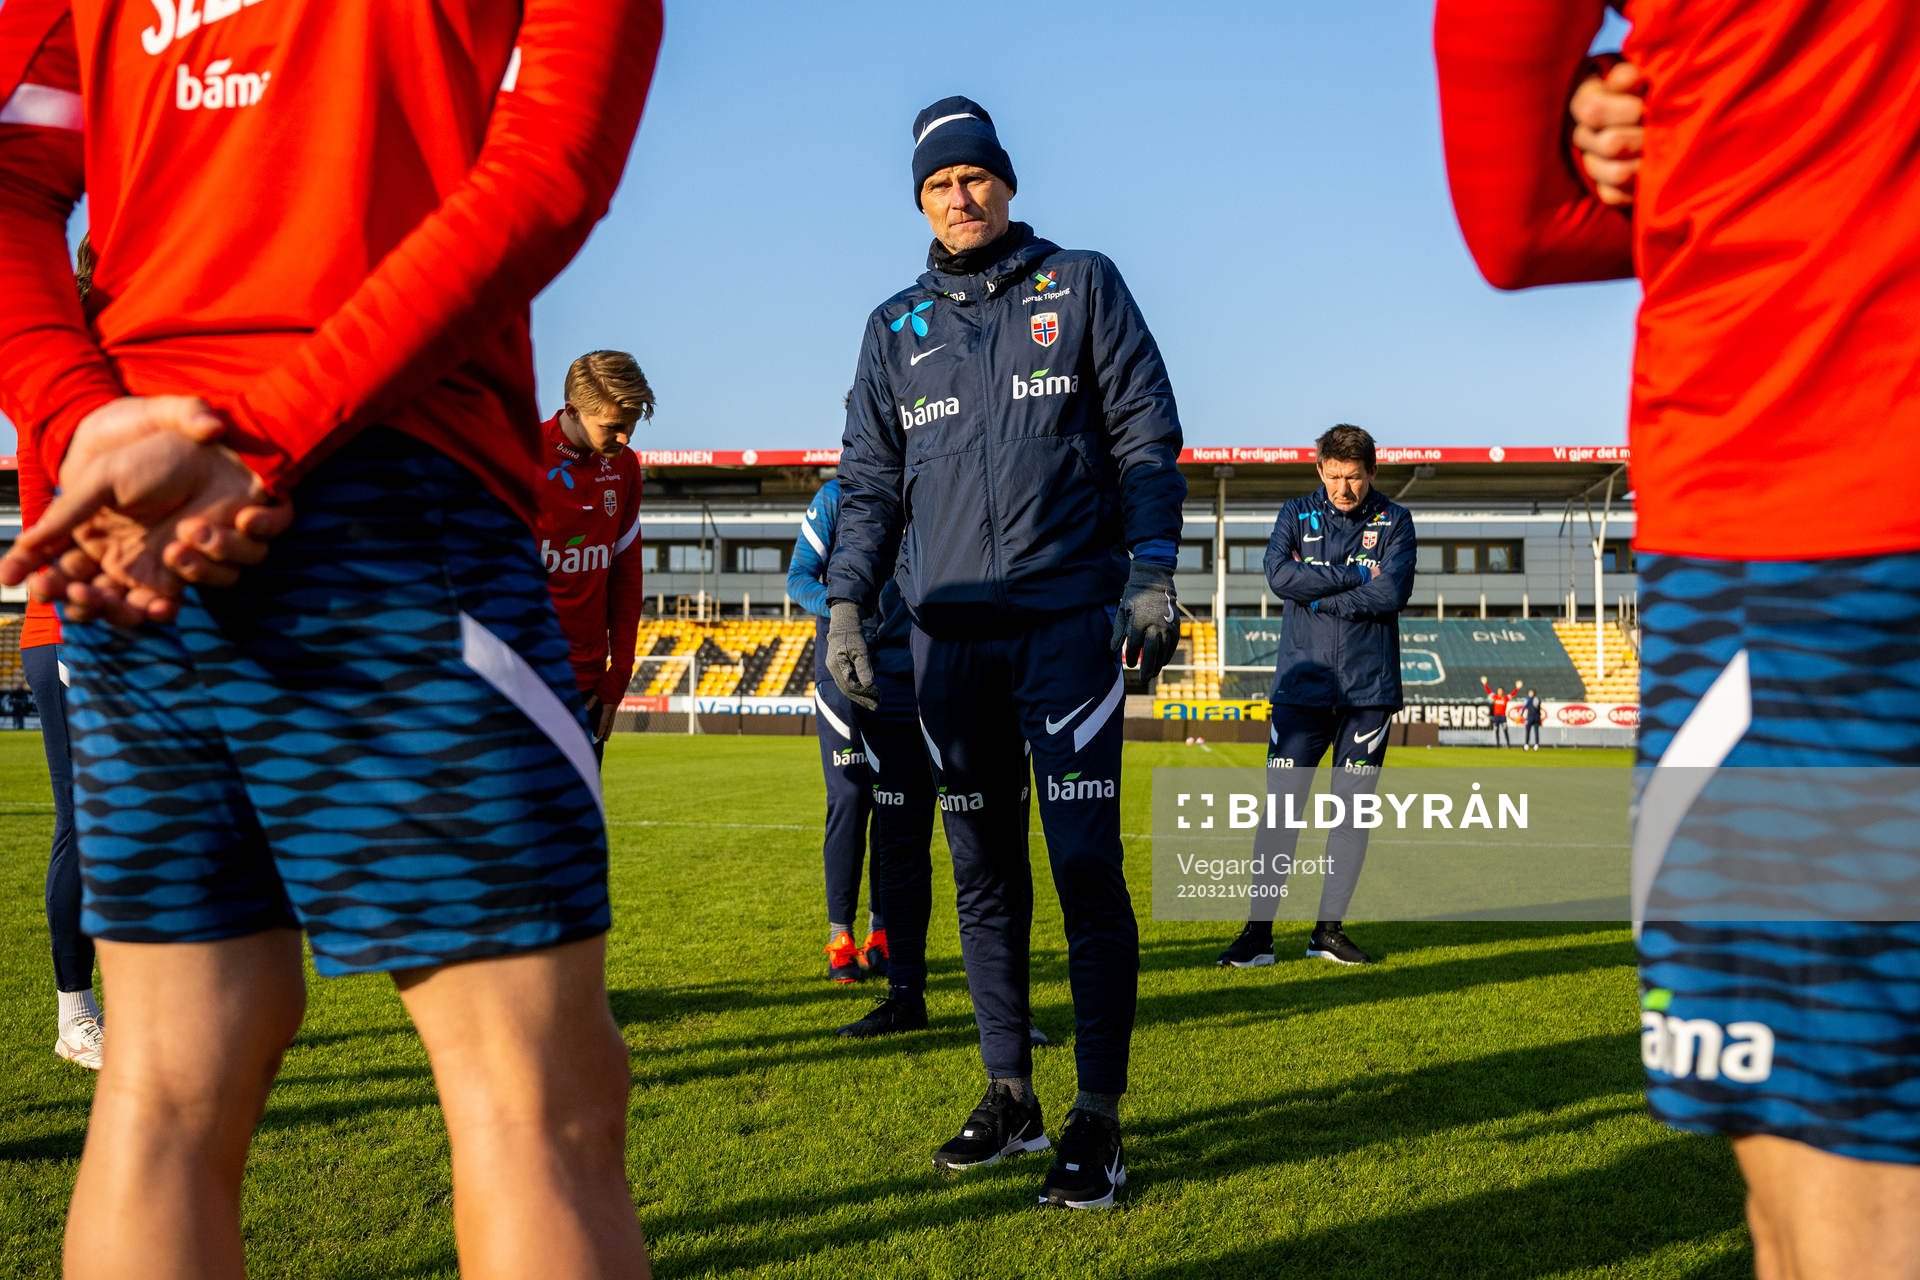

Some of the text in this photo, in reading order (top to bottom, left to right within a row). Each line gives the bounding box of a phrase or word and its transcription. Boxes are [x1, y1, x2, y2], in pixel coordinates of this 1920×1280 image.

[1022, 287, 1071, 305] Norsk Tipping
[1012, 369, 1079, 400] bama
[901, 396, 960, 430] bama
[641, 451, 713, 464] TRIBUNEN
[1193, 448, 1298, 461] Norsk Ferdigplen
[1376, 448, 1441, 463] digplen.no
[1553, 447, 1567, 459] Vi
[1596, 447, 1618, 459] det
[541, 537, 615, 573] bam
[1472, 630, 1526, 644] DNB
[1047, 774, 1115, 801] bama
[939, 792, 984, 812] ama
[1640, 1008, 1775, 1083] ama
